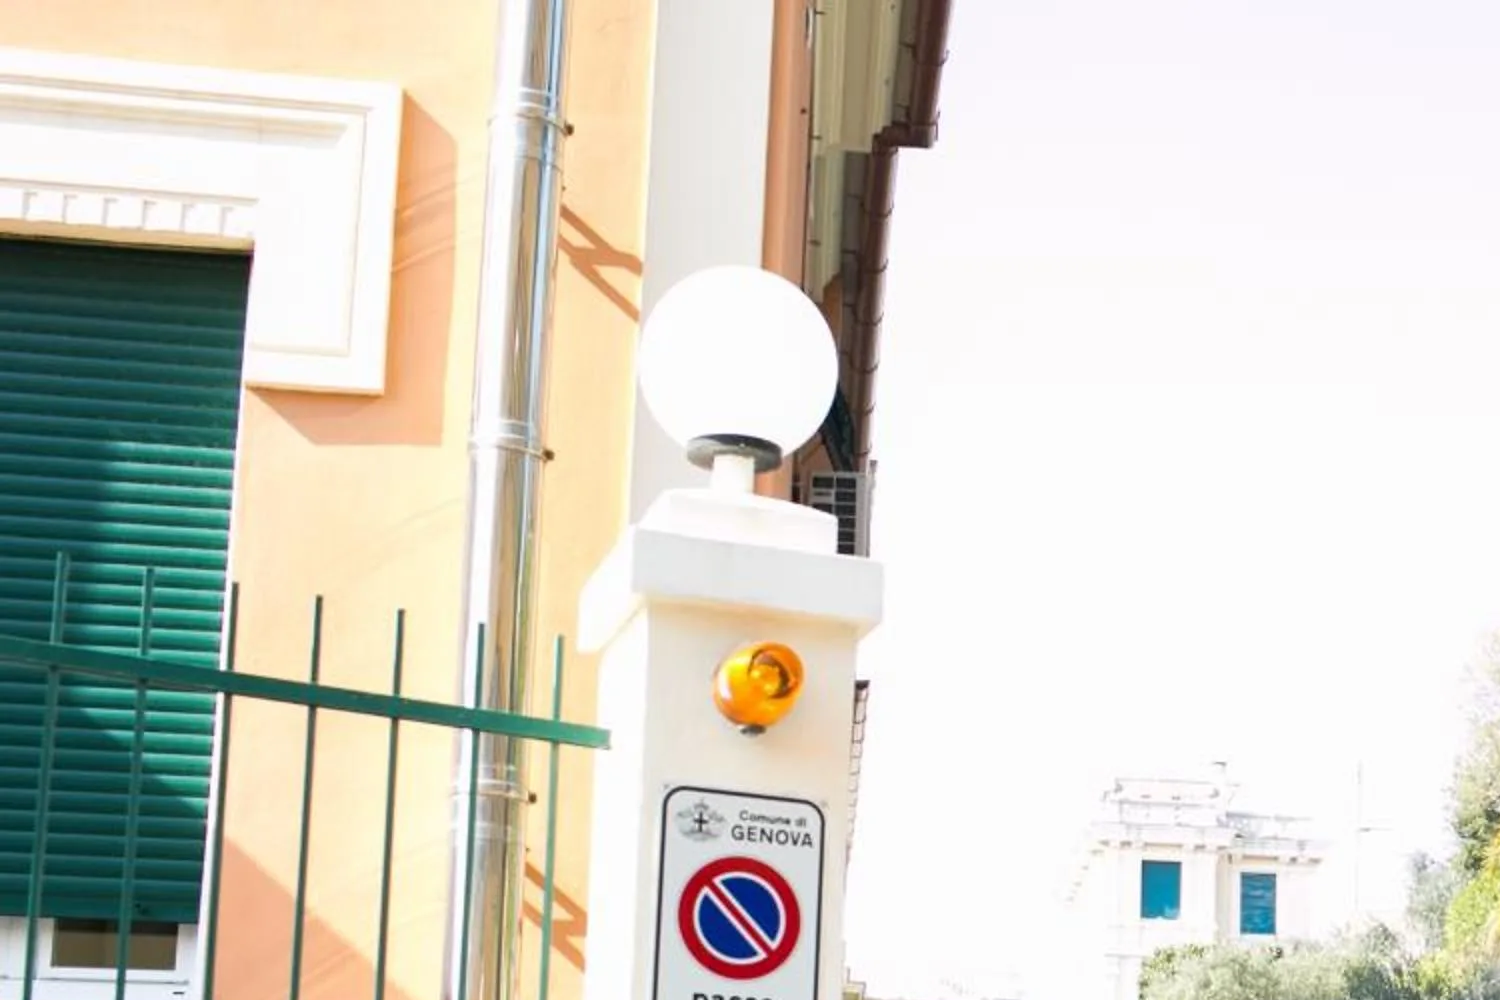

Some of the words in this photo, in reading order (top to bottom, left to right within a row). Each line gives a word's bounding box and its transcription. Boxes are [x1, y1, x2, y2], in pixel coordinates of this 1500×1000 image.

[739, 810, 791, 825] Comune
[795, 817, 807, 828] di
[731, 824, 813, 848] GENOVA
